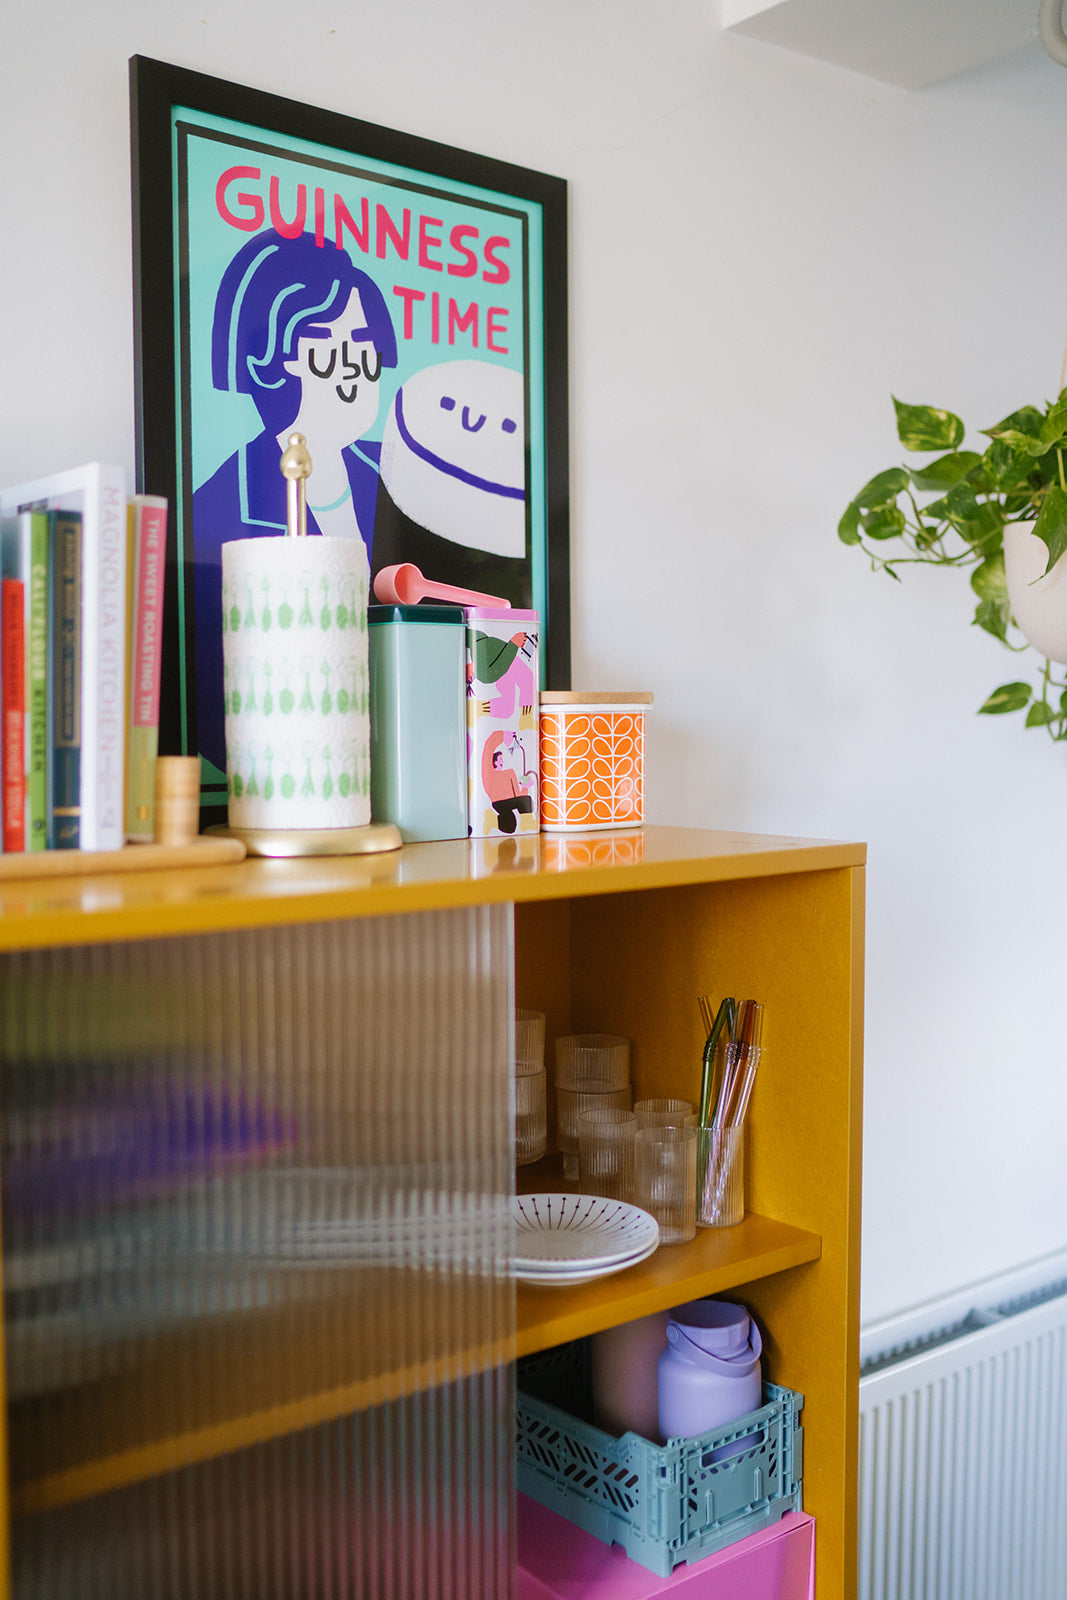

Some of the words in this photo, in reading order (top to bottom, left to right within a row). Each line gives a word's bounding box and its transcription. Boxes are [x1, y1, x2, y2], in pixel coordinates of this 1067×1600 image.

[215, 165, 510, 285] GUINNESS
[393, 285, 509, 354] TIME
[100, 487, 121, 628] MAGNOLIA
[147, 519, 160, 548] THE
[144, 552, 159, 608] SWEET
[140, 611, 157, 691] ROASTING
[100, 639, 120, 752] KITCHEN
[139, 694, 153, 722] TIN
